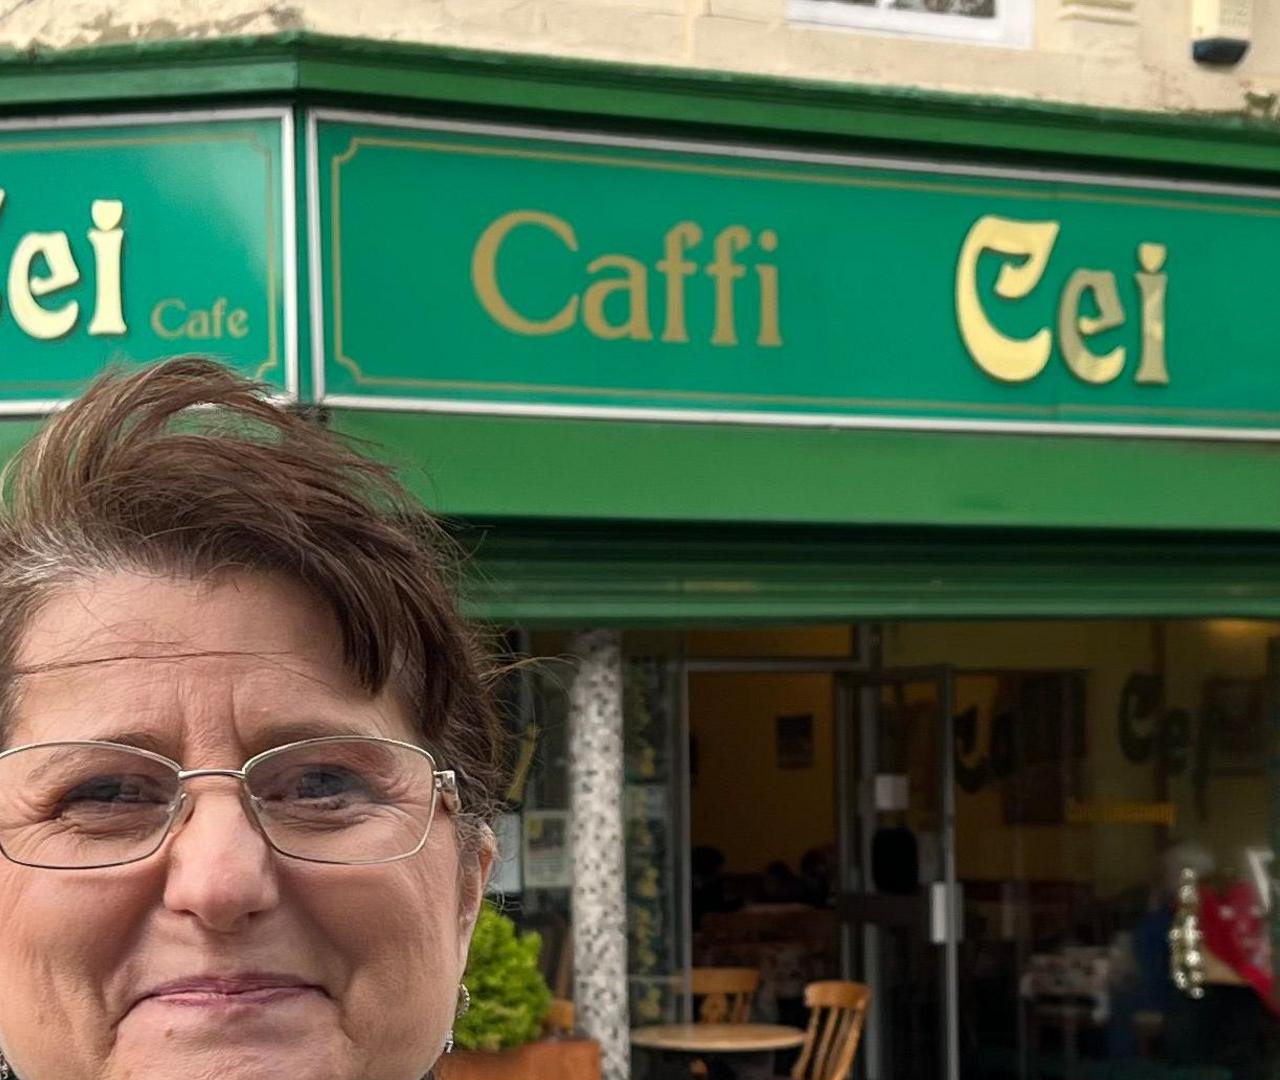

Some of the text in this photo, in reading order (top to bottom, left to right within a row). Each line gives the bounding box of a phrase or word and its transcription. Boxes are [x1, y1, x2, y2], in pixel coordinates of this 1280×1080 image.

[150, 298, 249, 339] Cafe
[472, 208, 783, 347] Caffi
[954, 214, 1169, 384] Cei
